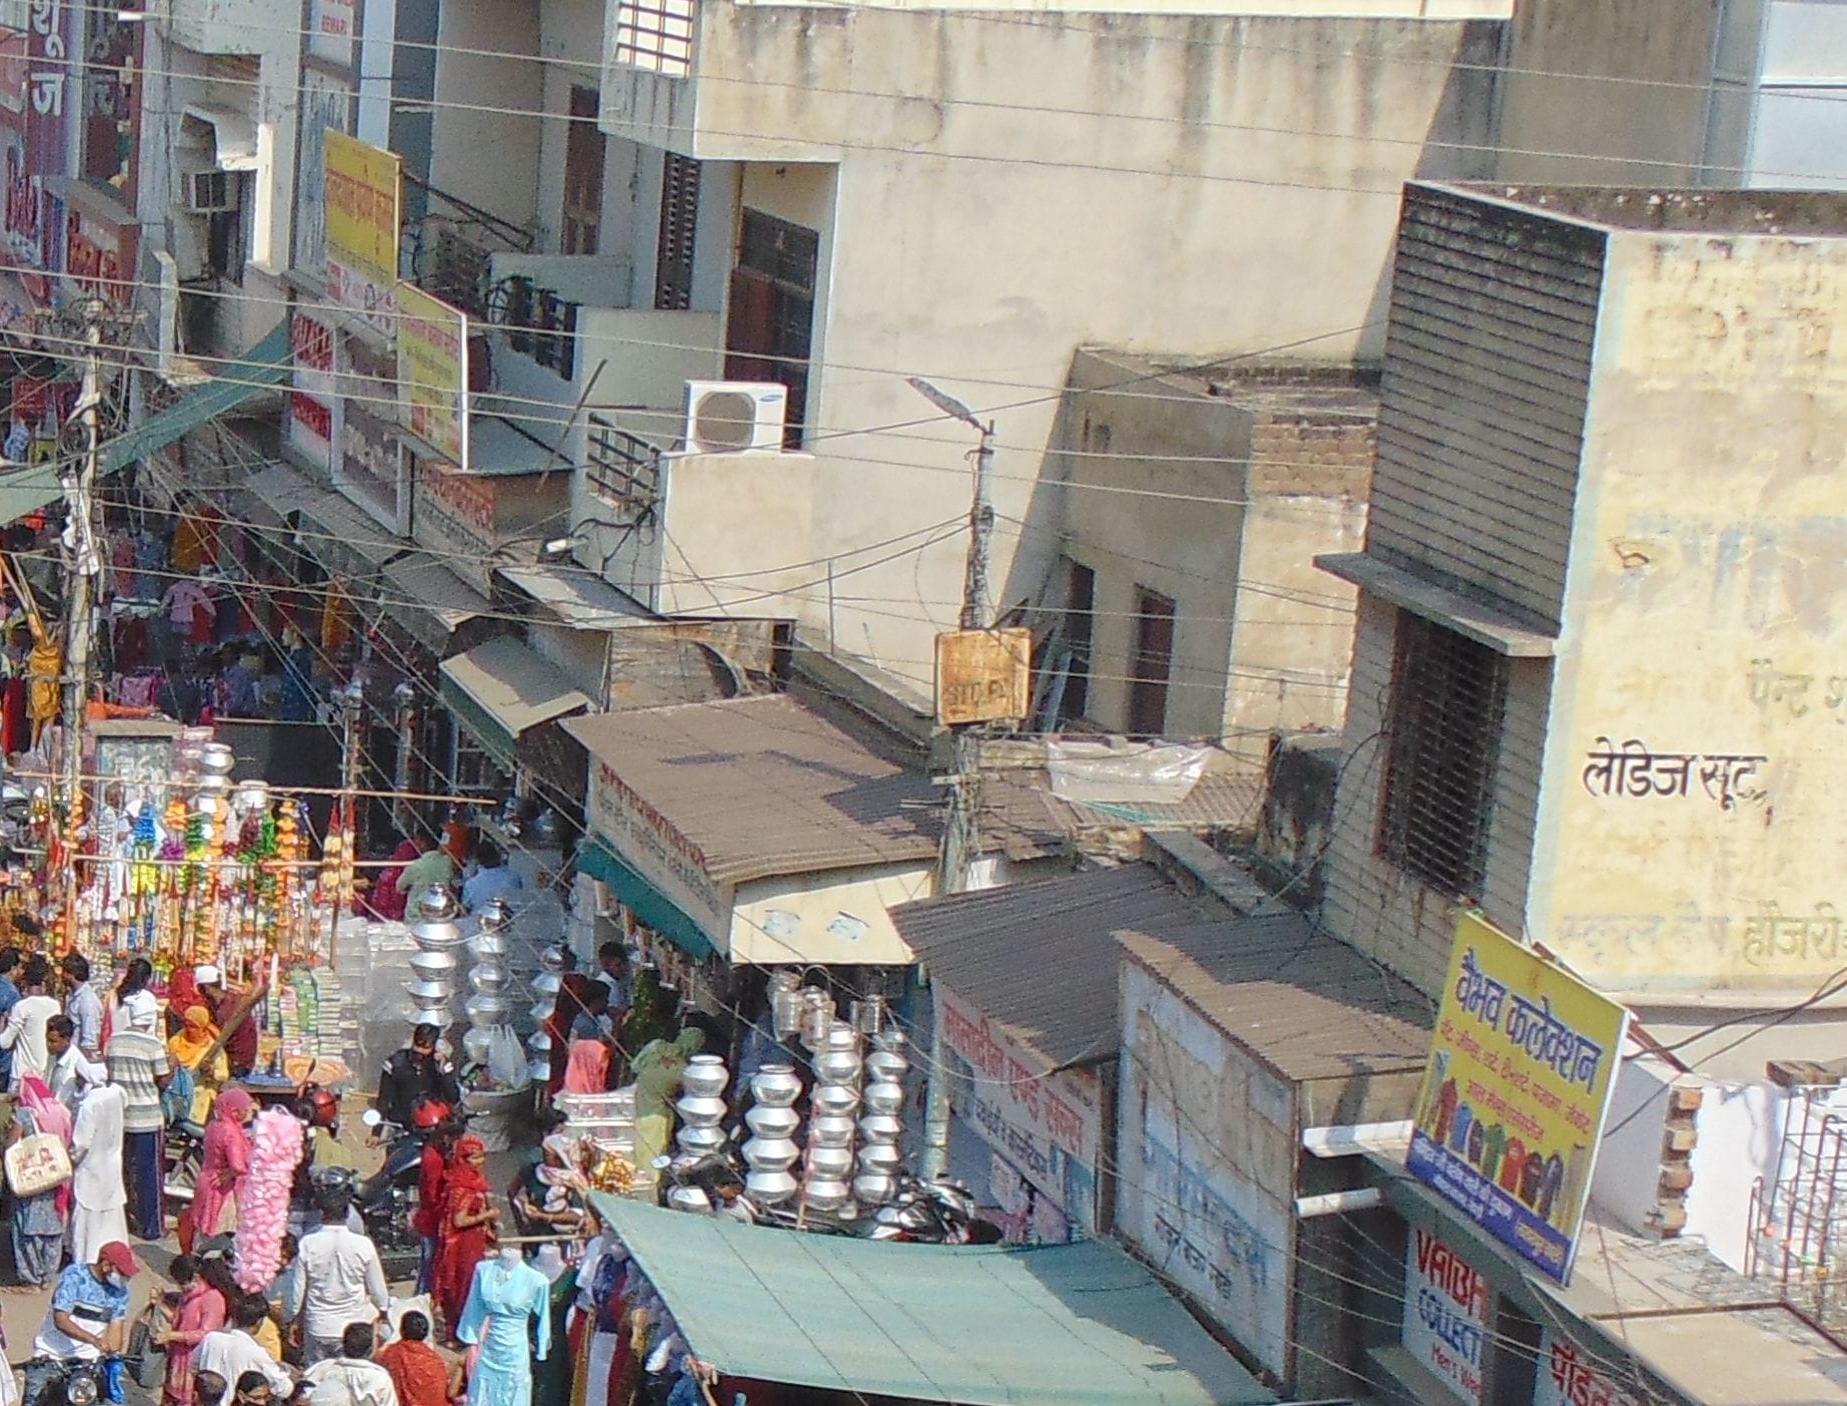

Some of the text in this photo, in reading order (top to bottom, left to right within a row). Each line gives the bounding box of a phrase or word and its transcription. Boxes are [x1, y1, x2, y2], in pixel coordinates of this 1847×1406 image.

[1582, 736, 1697, 800] लेडिज
[1456, 944, 1604, 1095] वैभव कलेक्शन
